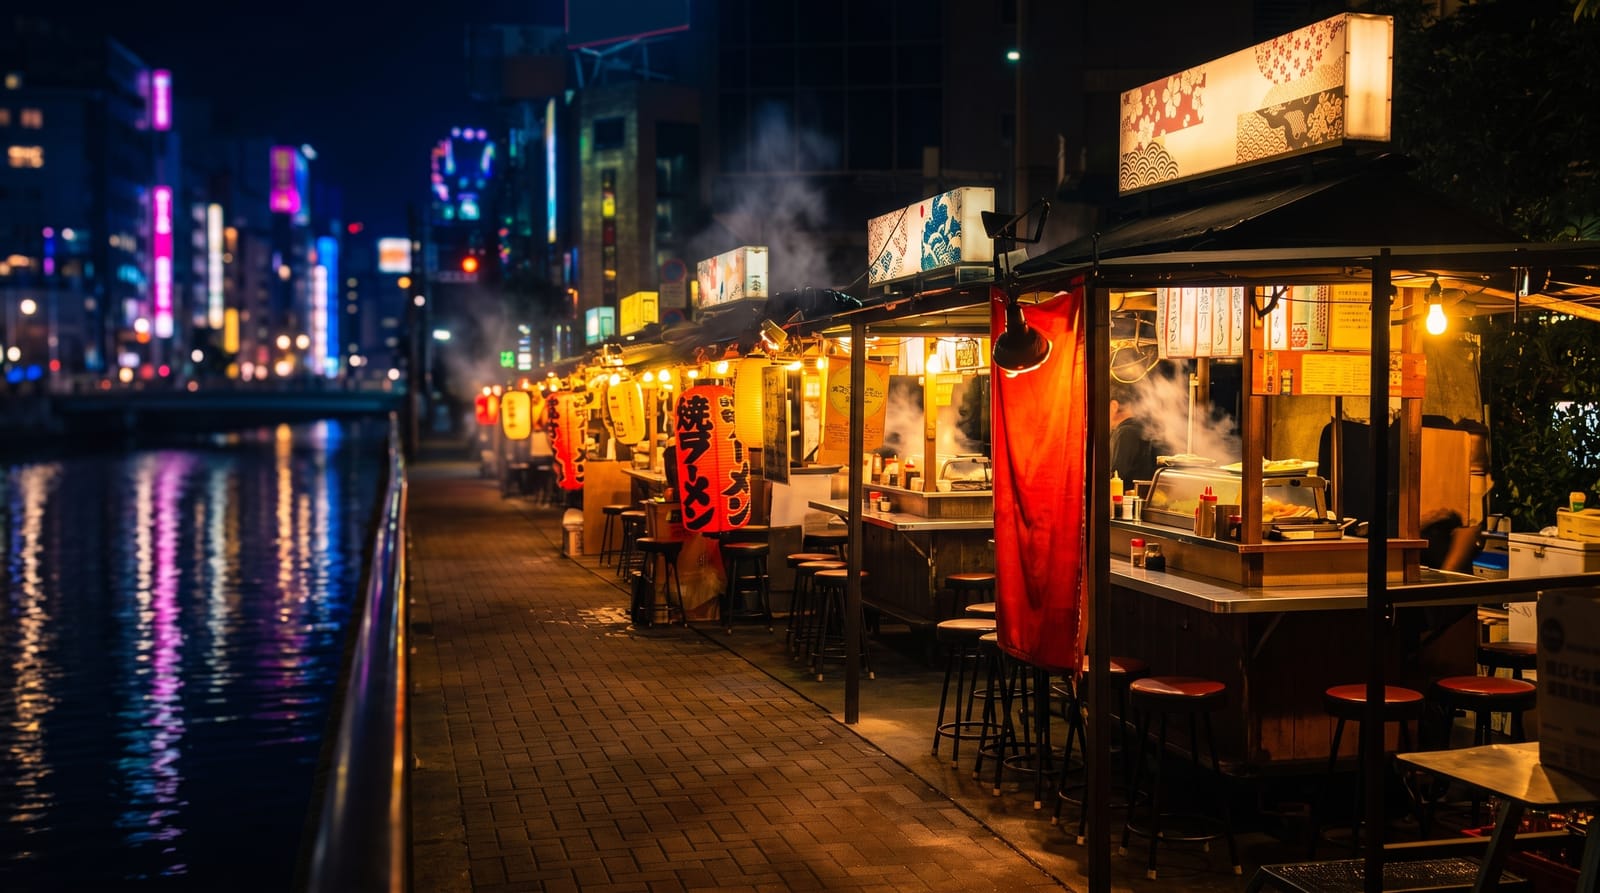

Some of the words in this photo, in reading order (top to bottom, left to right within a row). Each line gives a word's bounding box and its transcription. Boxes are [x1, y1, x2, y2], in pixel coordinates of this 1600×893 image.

[677, 395, 715, 531] 焼ラーメン
